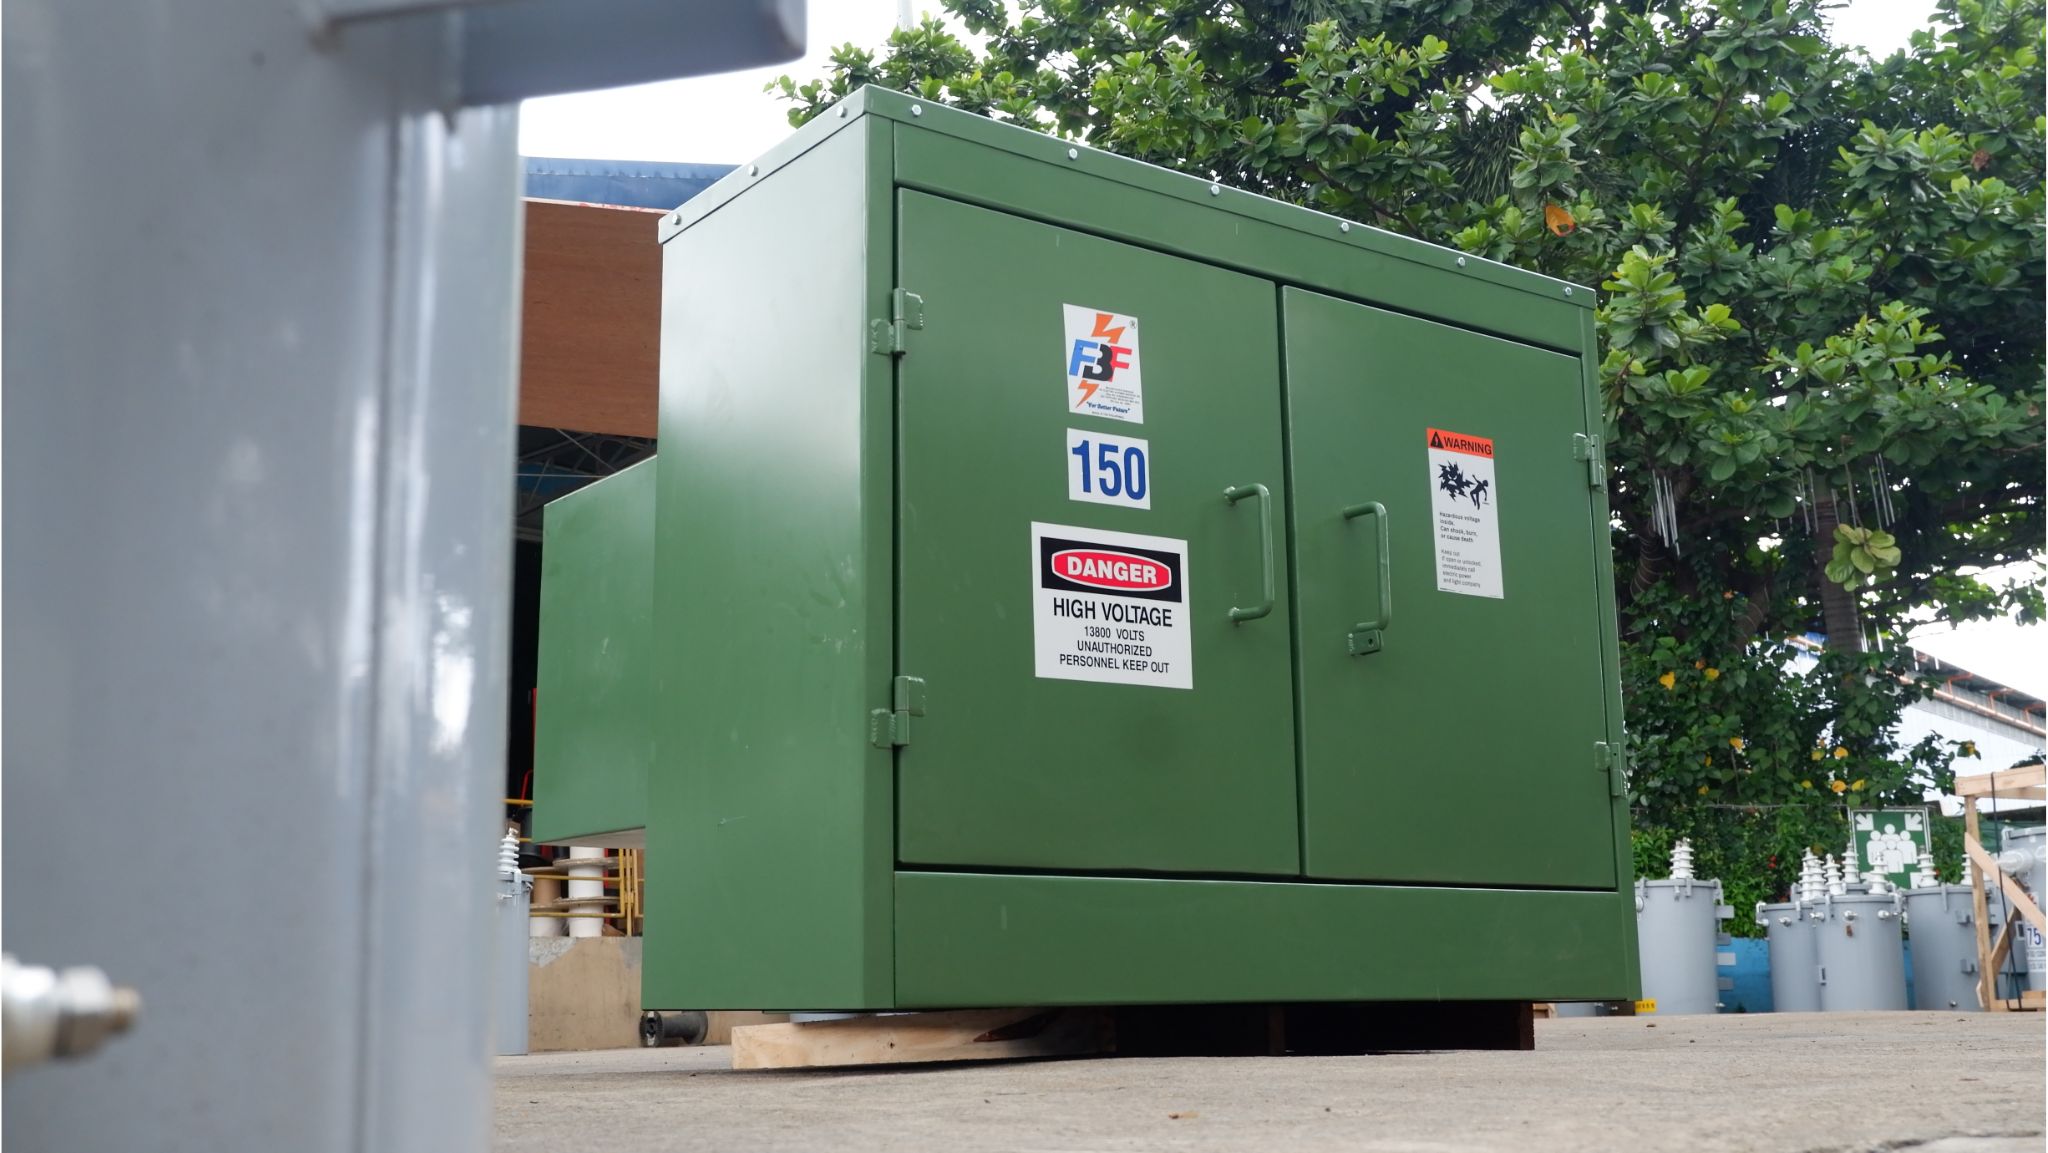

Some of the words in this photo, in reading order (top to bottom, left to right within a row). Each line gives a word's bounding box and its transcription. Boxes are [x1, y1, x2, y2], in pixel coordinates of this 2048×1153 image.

[1444, 436, 1492, 455] WARNING
[1072, 440, 1146, 500] 150
[1067, 556, 1157, 584] DANGER
[1054, 597, 1096, 620] HIGH
[1102, 602, 1172, 627] VOLTAGE
[1084, 626, 1110, 638] 13800
[1116, 628, 1145, 642] VOLTS
[1077, 640, 1152, 657] UNAUTHORIZED
[1060, 654, 1120, 670] PERSONNEL
[1123, 660, 1148, 671] KEEP
[1151, 662, 1169, 673] OUT
[2027, 928, 2042, 945] 75
